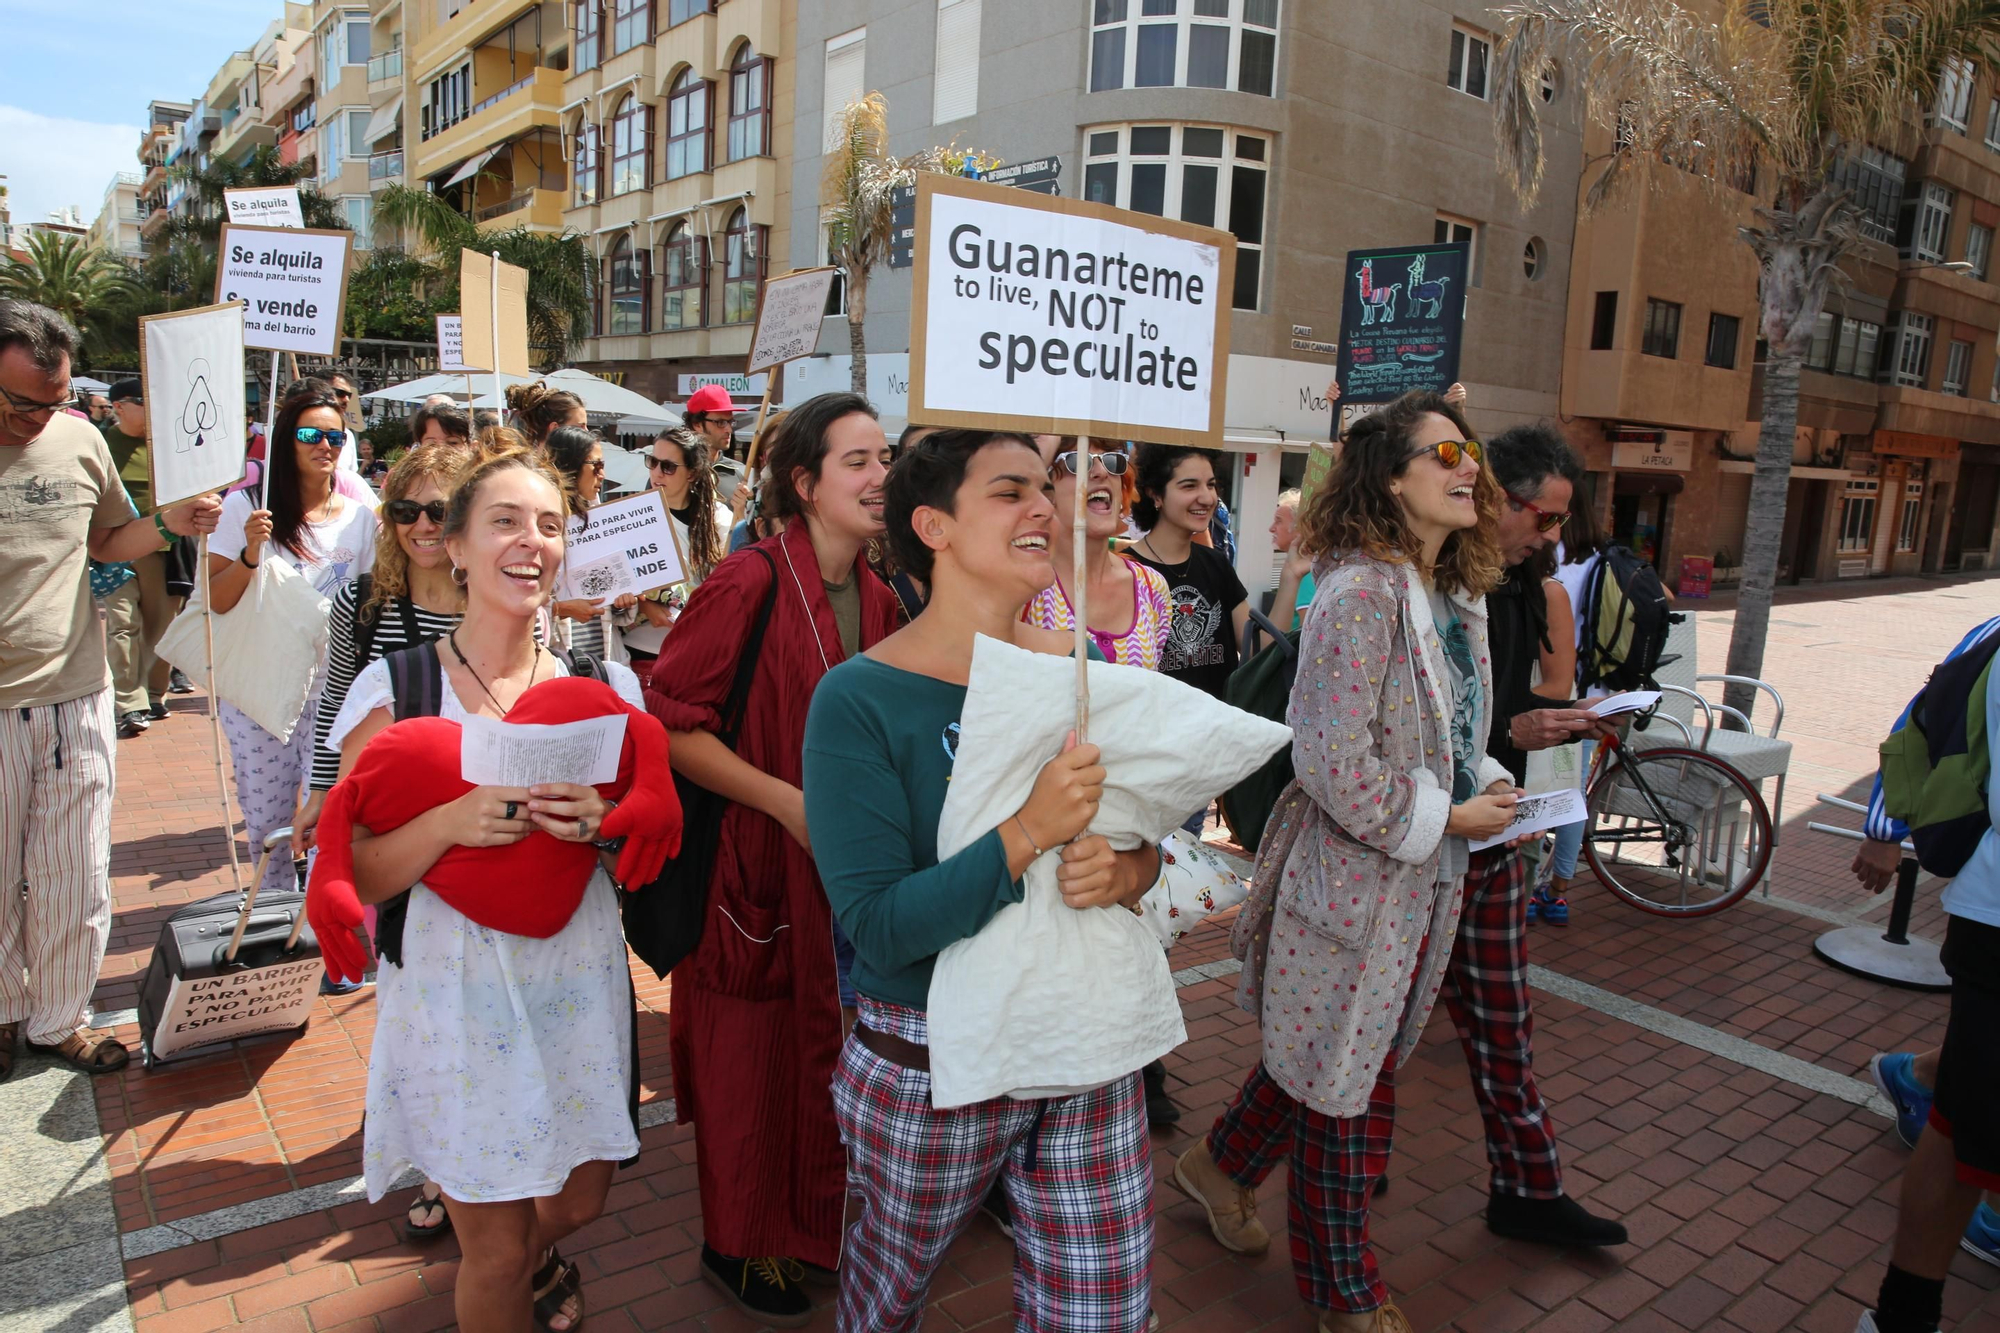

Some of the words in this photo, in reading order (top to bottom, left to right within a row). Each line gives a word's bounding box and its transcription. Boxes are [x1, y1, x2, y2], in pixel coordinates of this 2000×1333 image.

[988, 164, 1022, 181] INFORMACIÓN
[1022, 160, 1049, 174] TURÍSTICA
[232, 200, 247, 210] Se
[250, 198, 288, 210] alquila
[231, 245, 254, 264] Se
[260, 249, 323, 271] alquila
[948, 223, 1204, 305] Guanarteme
[228, 268, 264, 279] vivienda
[266, 273, 286, 281] para
[288, 273, 322, 284] turistas
[257, 299, 318, 319] vende
[954, 274, 980, 299] to
[989, 275, 1038, 311] live,
[1048, 288, 1126, 335] NOT
[1140, 318, 1158, 340] to
[264, 321, 280, 332] del
[284, 323, 316, 336] barrio
[1294, 326, 1311, 336] CALLE
[1350, 330, 1359, 338] La
[1293, 340, 1310, 349] GRAN
[1311, 343, 1337, 353] CANARIA
[1375, 337, 1400, 346] DESTINO
[1402, 336, 1434, 345] CULINARIO
[978, 331, 1198, 392] speculate
[1348, 385, 1373, 395] Leading
[1641, 455, 1649, 465] LA
[1651, 455, 1672, 466] PETACA
[602, 513, 627, 526] PARA
[628, 505, 654, 518] VIVIR
[576, 533, 601, 546] PARA
[603, 516, 658, 537] ESPECULAR
[633, 560, 668, 578] NDE
[191, 978, 224, 992] UN
[233, 961, 320, 985] BARRIO
[188, 989, 248, 1005] PARA
[259, 974, 312, 993] VIVIR
[185, 1008, 198, 1017] Y
[205, 1001, 240, 1014] NO
[248, 987, 303, 1006] PARA
[175, 998, 303, 1033] ESPECULAR
